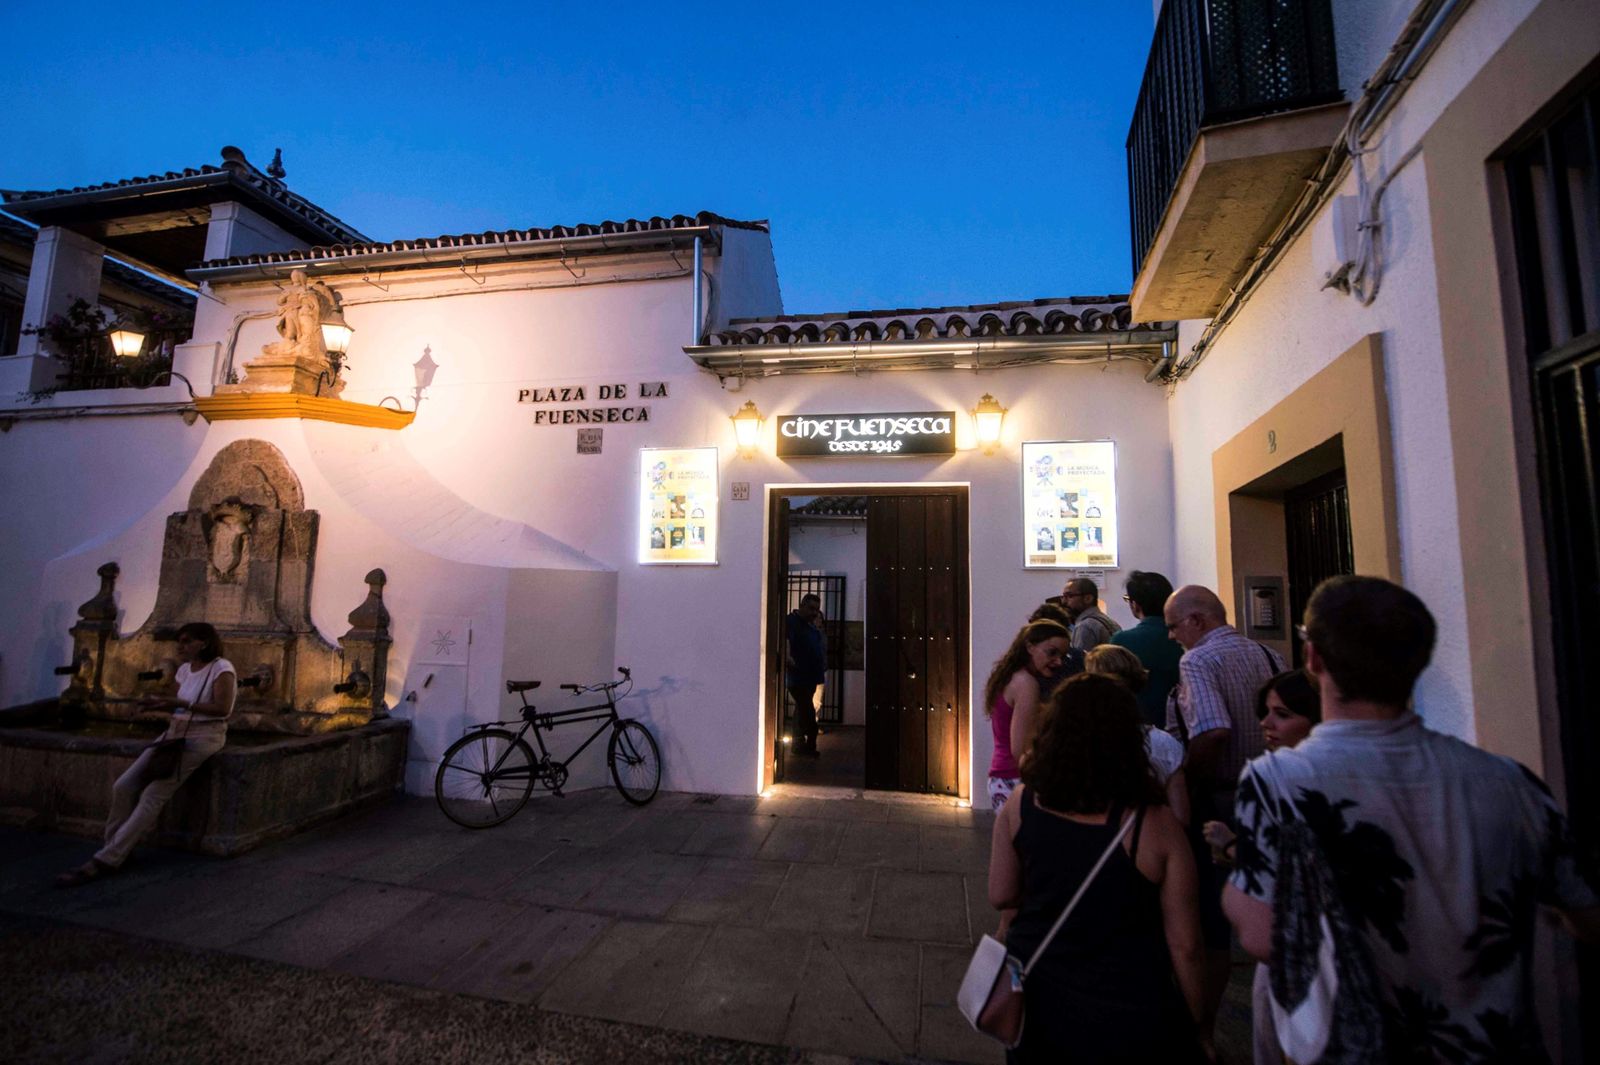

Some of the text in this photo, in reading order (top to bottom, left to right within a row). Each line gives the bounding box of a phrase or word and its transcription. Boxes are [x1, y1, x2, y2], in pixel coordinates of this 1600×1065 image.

[517, 382, 668, 403] PLAZA DE LA
[534, 407, 649, 424] FUENSECA
[871, 439, 903, 453] 1945
